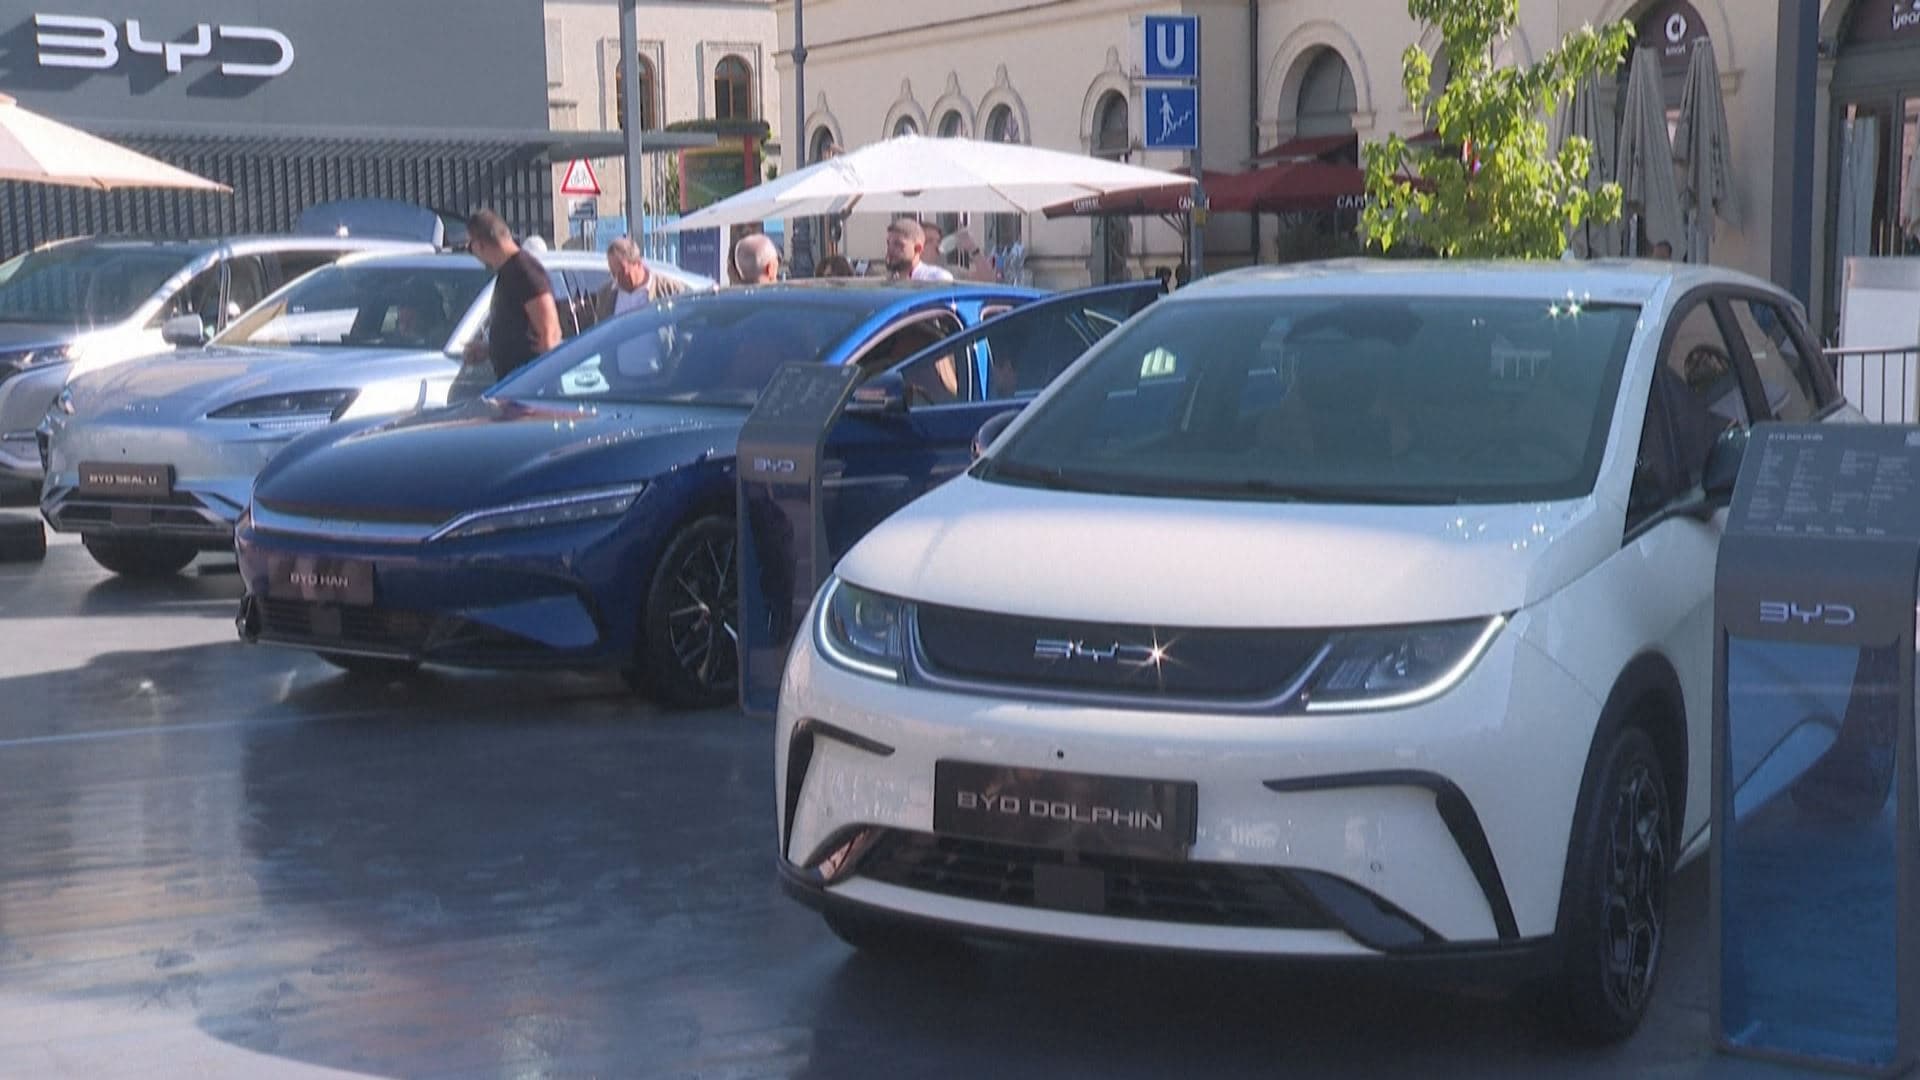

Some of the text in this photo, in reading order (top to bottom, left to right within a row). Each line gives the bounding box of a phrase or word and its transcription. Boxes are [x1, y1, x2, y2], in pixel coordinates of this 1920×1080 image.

[34, 13, 294, 76] BYD
[1156, 23, 1185, 68] U
[88, 472, 114, 485] BYD
[753, 457, 796, 473] BYD
[289, 572, 350, 588] BYD HAN
[1759, 601, 1856, 626] BYD
[1033, 638, 1164, 667] BYD
[957, 790, 1163, 831] BYD DOLPHIN
